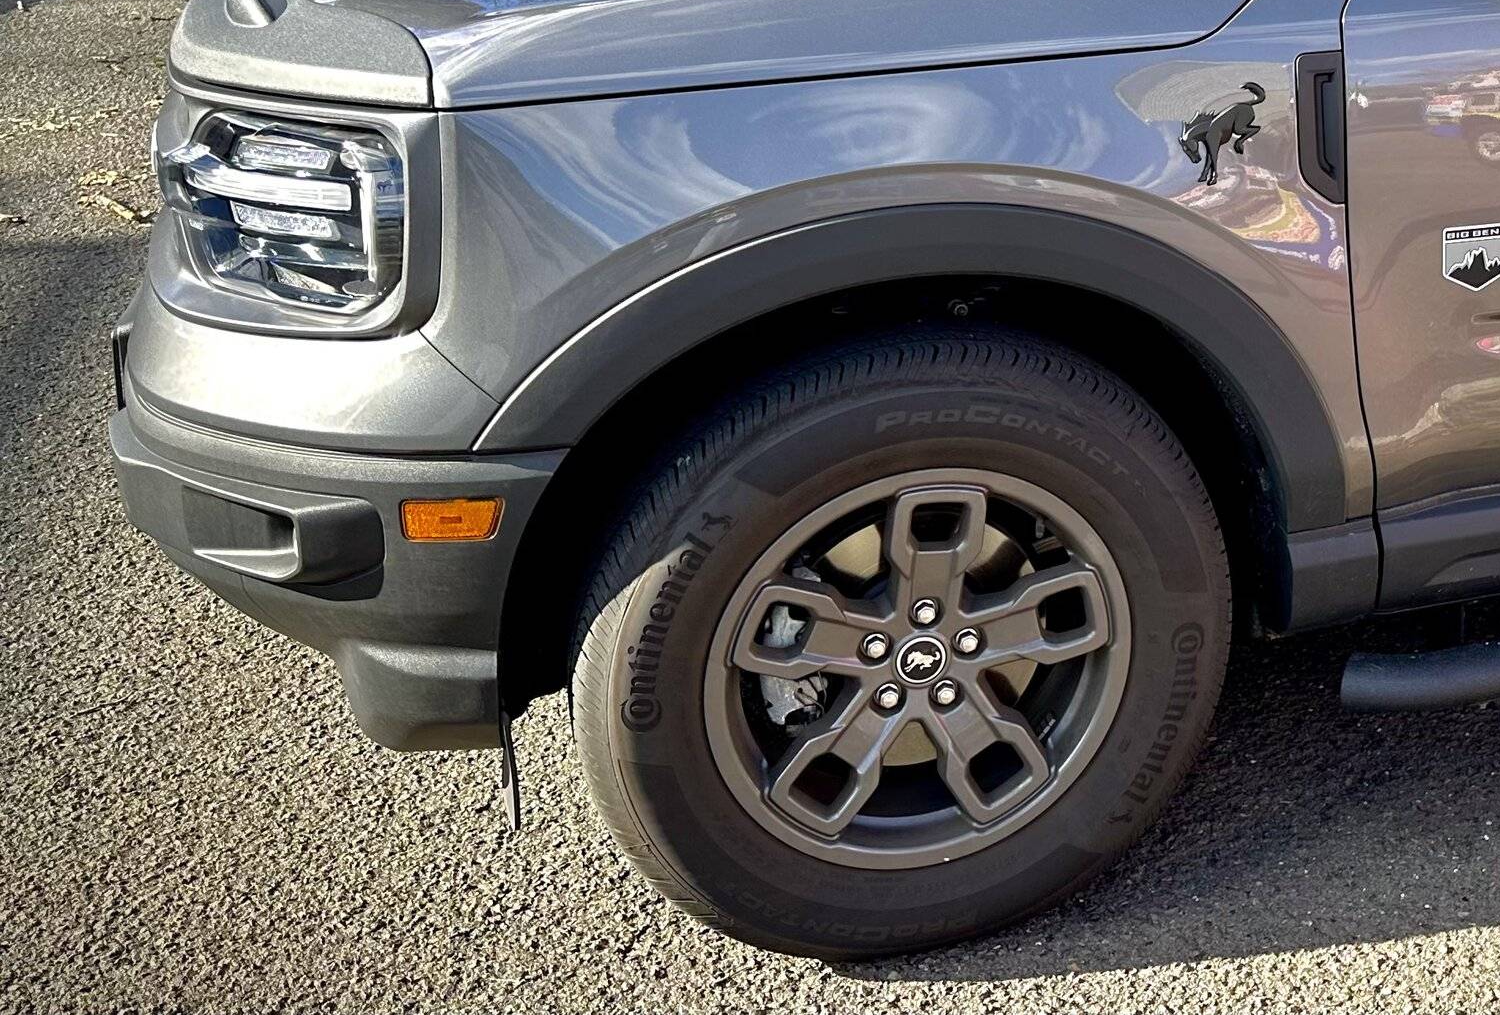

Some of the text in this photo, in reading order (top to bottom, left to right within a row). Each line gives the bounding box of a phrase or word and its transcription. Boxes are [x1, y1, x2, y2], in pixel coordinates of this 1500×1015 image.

[1446, 231, 1470, 240] BIG
[619, 532, 716, 733] Continental
[1121, 621, 1205, 805] Continental
